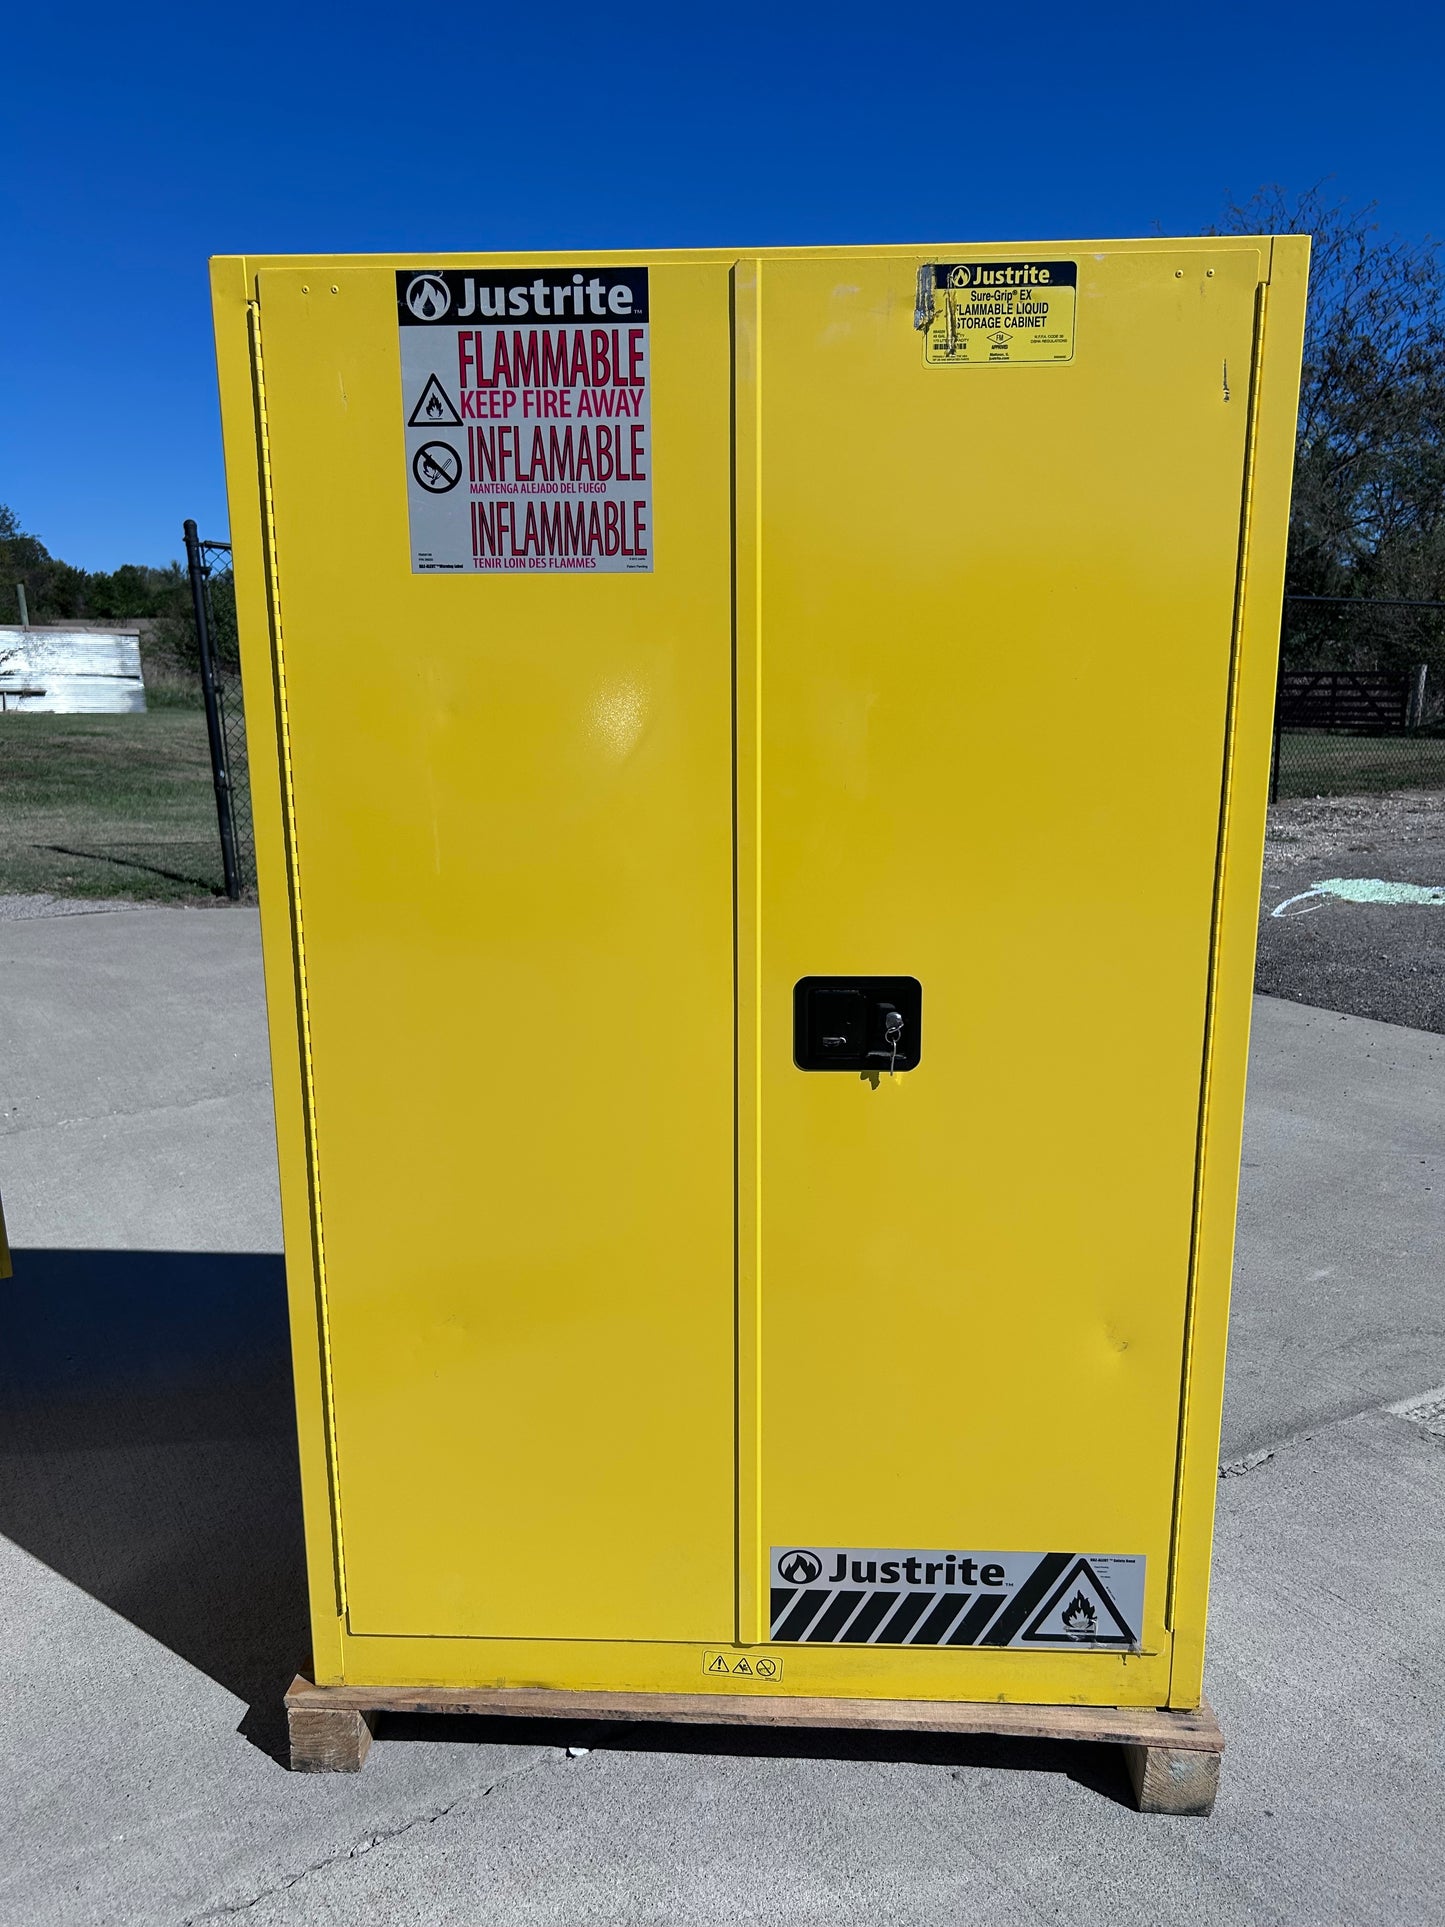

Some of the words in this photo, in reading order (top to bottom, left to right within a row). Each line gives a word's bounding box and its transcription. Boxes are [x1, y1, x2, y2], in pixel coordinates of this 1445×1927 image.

[972, 264, 1050, 285] Justrite
[457, 273, 634, 317] Justrite
[1020, 289, 1032, 301] EX
[1016, 302, 1049, 315] LIQUID
[1004, 316, 1047, 328] CABINET
[457, 328, 646, 389] FLAMMABLE
[460, 390, 517, 419] KEEP
[522, 389, 572, 419] FIRE
[576, 388, 645, 418] AWAY
[467, 424, 646, 482] INFLAMABLE
[469, 483, 519, 494] MANTENGA
[520, 483, 559, 494] ALEJADO
[560, 483, 576, 494] DEL
[578, 482, 607, 494] FUEGO
[470, 500, 648, 557] INFLAMMABLE
[473, 557, 502, 569] TENIR
[504, 557, 527, 569] LOIN
[529, 557, 547, 569] DES
[549, 557, 597, 569] FLAMMES
[828, 1553, 1006, 1587] Justrite
